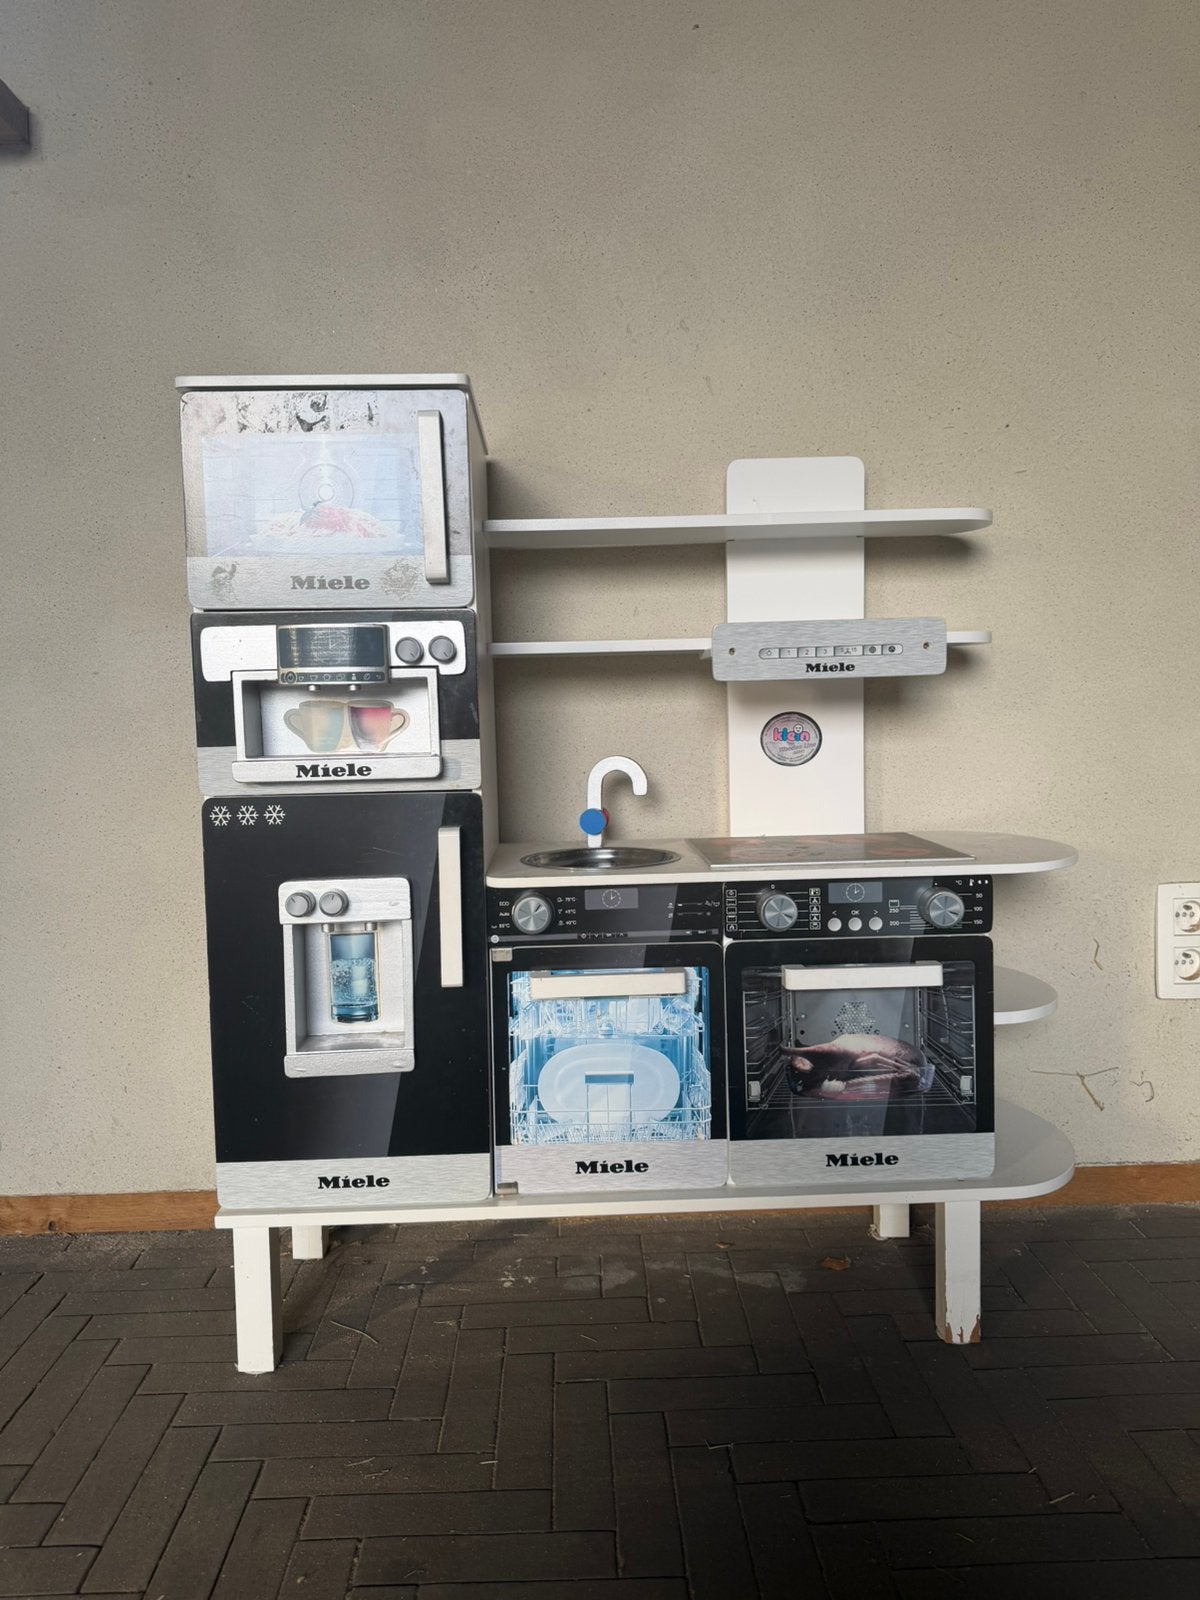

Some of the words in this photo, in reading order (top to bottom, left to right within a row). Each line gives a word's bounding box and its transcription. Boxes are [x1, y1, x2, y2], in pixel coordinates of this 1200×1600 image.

[290, 575, 371, 590] Miele
[805, 662, 856, 673] Miele
[773, 723, 810, 741] klein
[295, 763, 372, 778] Miele
[575, 1160, 649, 1174] Miele
[825, 1152, 899, 1167] Miele
[317, 1175, 390, 1189] Miele
